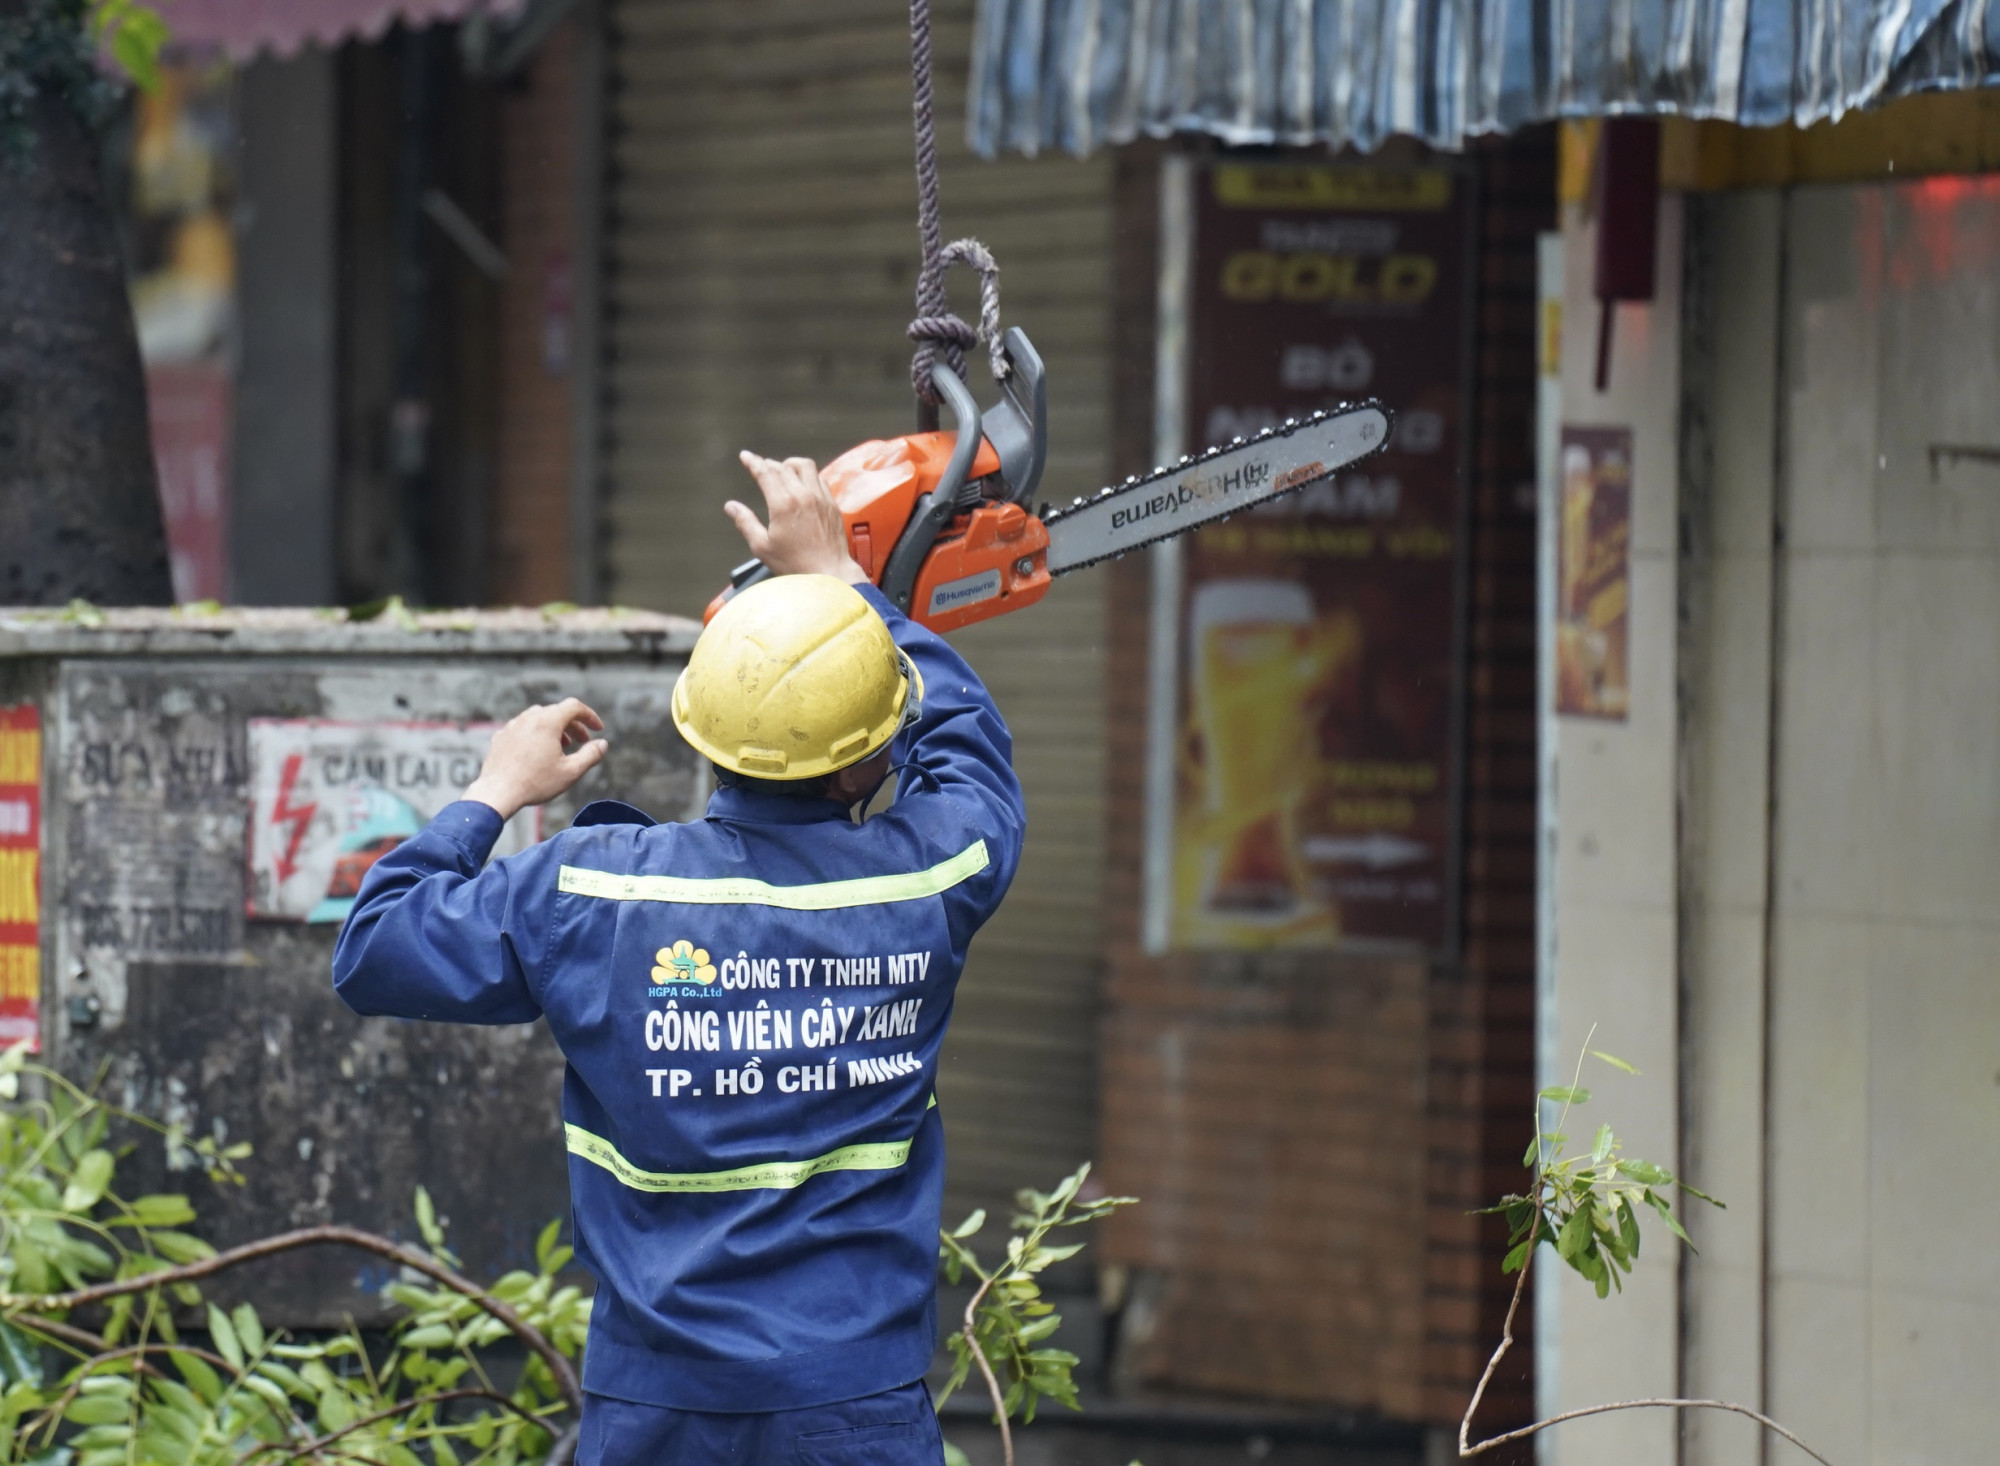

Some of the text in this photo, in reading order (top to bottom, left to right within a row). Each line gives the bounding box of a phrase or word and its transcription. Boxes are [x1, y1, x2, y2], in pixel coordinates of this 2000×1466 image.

[1222, 252, 1437, 302] GOLD
[947, 581, 995, 600] Husqvarna
[721, 950, 931, 990] CÔNG TY TNHH MTV
[648, 987, 723, 999] HGPA Co.,Ltd
[645, 998, 923, 1051] CÔNG VIÊN CÂY XANH
[646, 1051, 923, 1097] TP. HỒ CHÍ MINH
